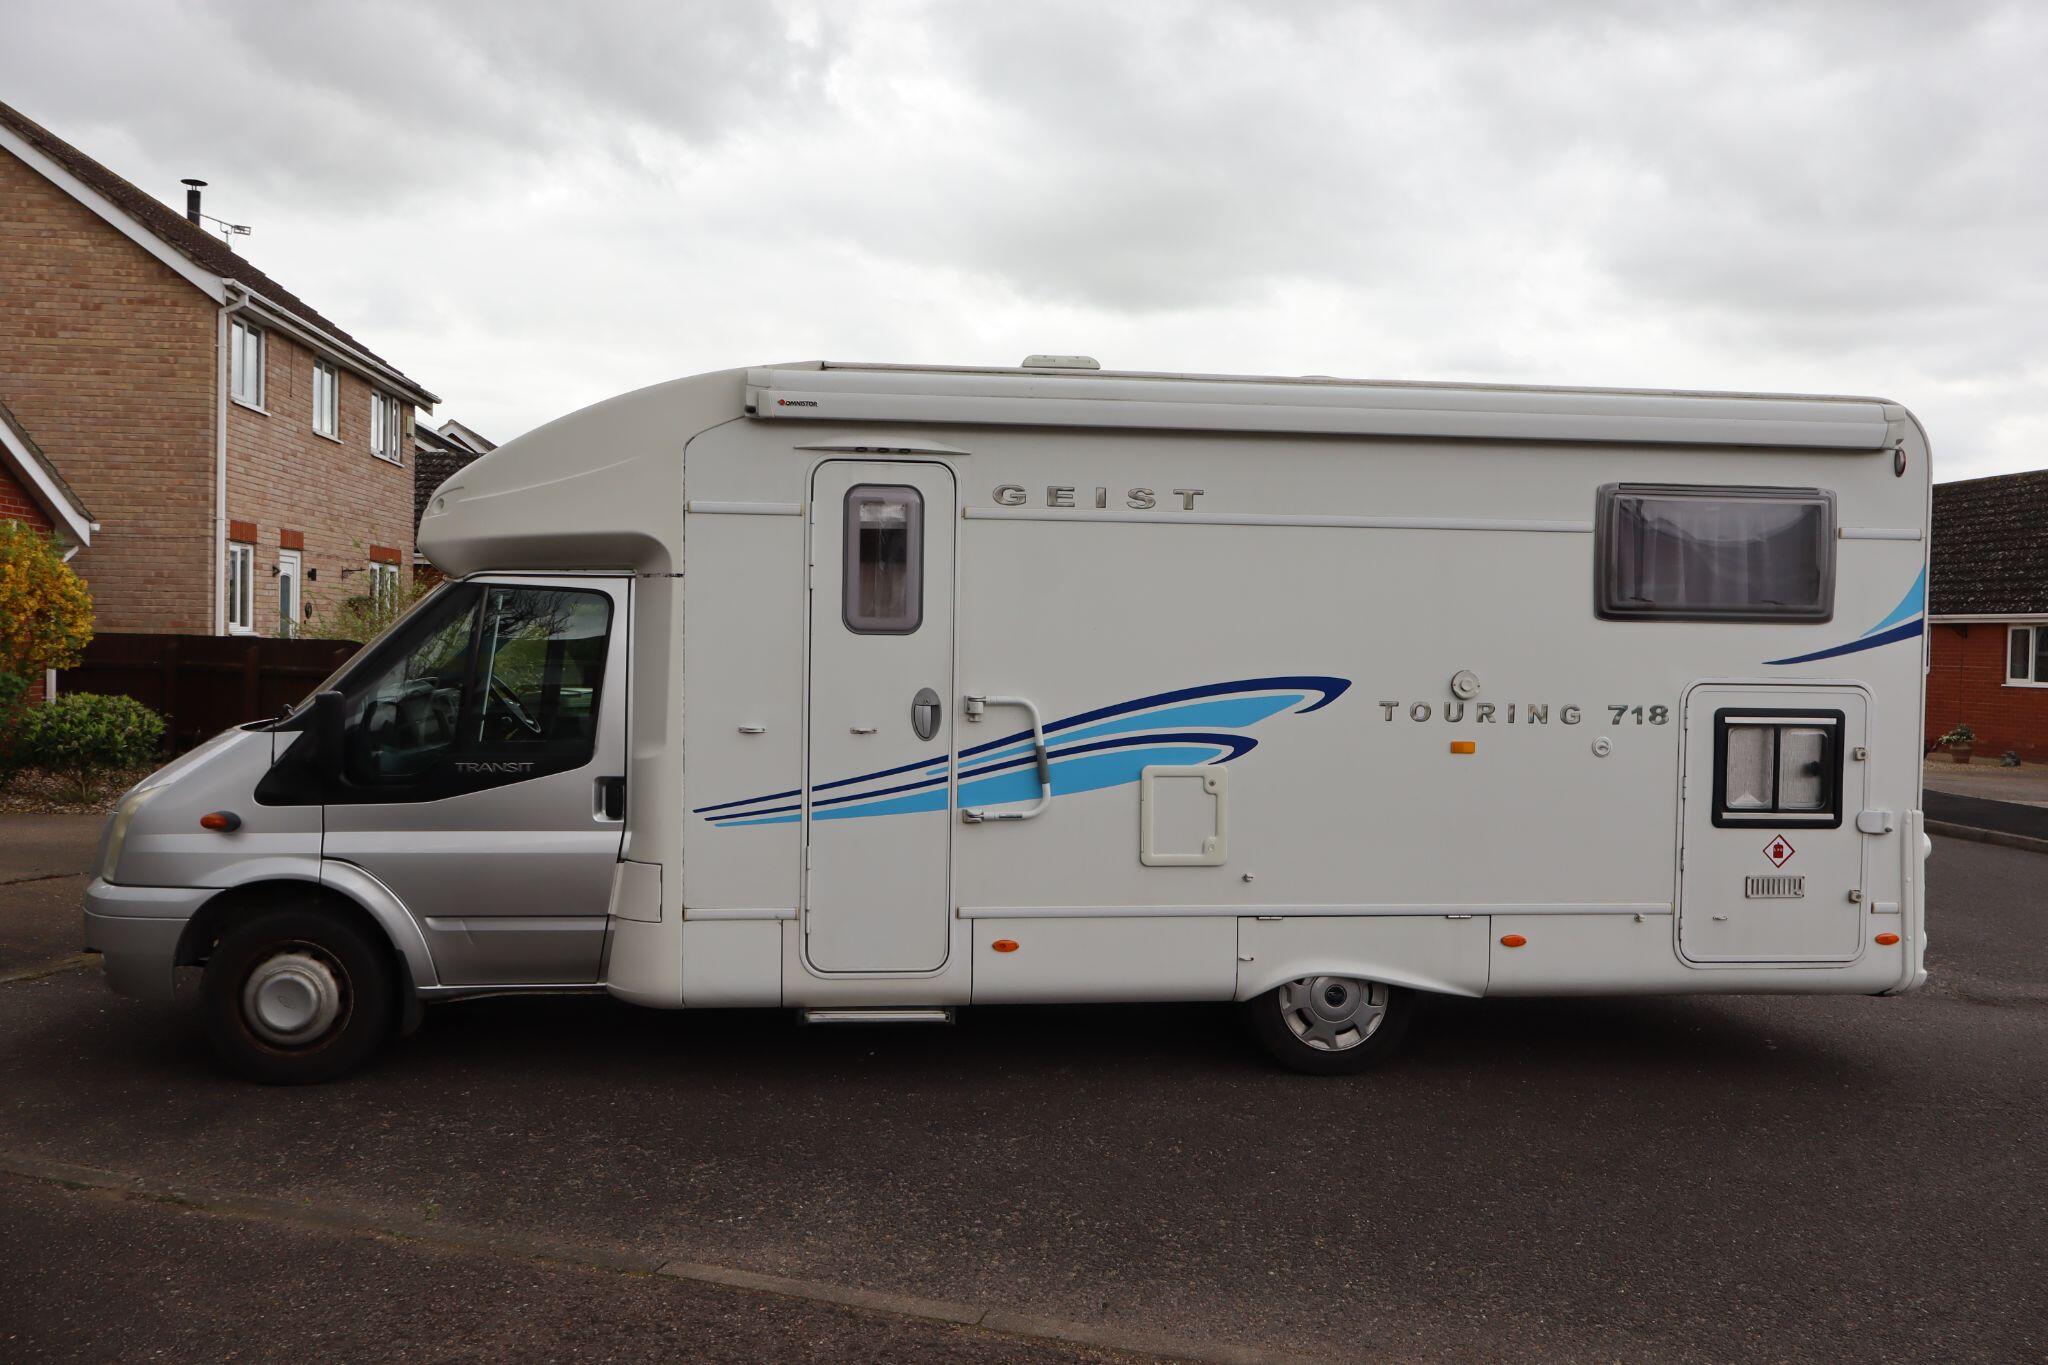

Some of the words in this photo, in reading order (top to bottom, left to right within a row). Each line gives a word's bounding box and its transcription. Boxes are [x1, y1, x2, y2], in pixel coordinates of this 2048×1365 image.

[992, 484, 1204, 511] GEIST
[1379, 701, 1581, 725] TOURING
[1607, 704, 1669, 726] 718
[455, 762, 535, 773] TRANSIT
